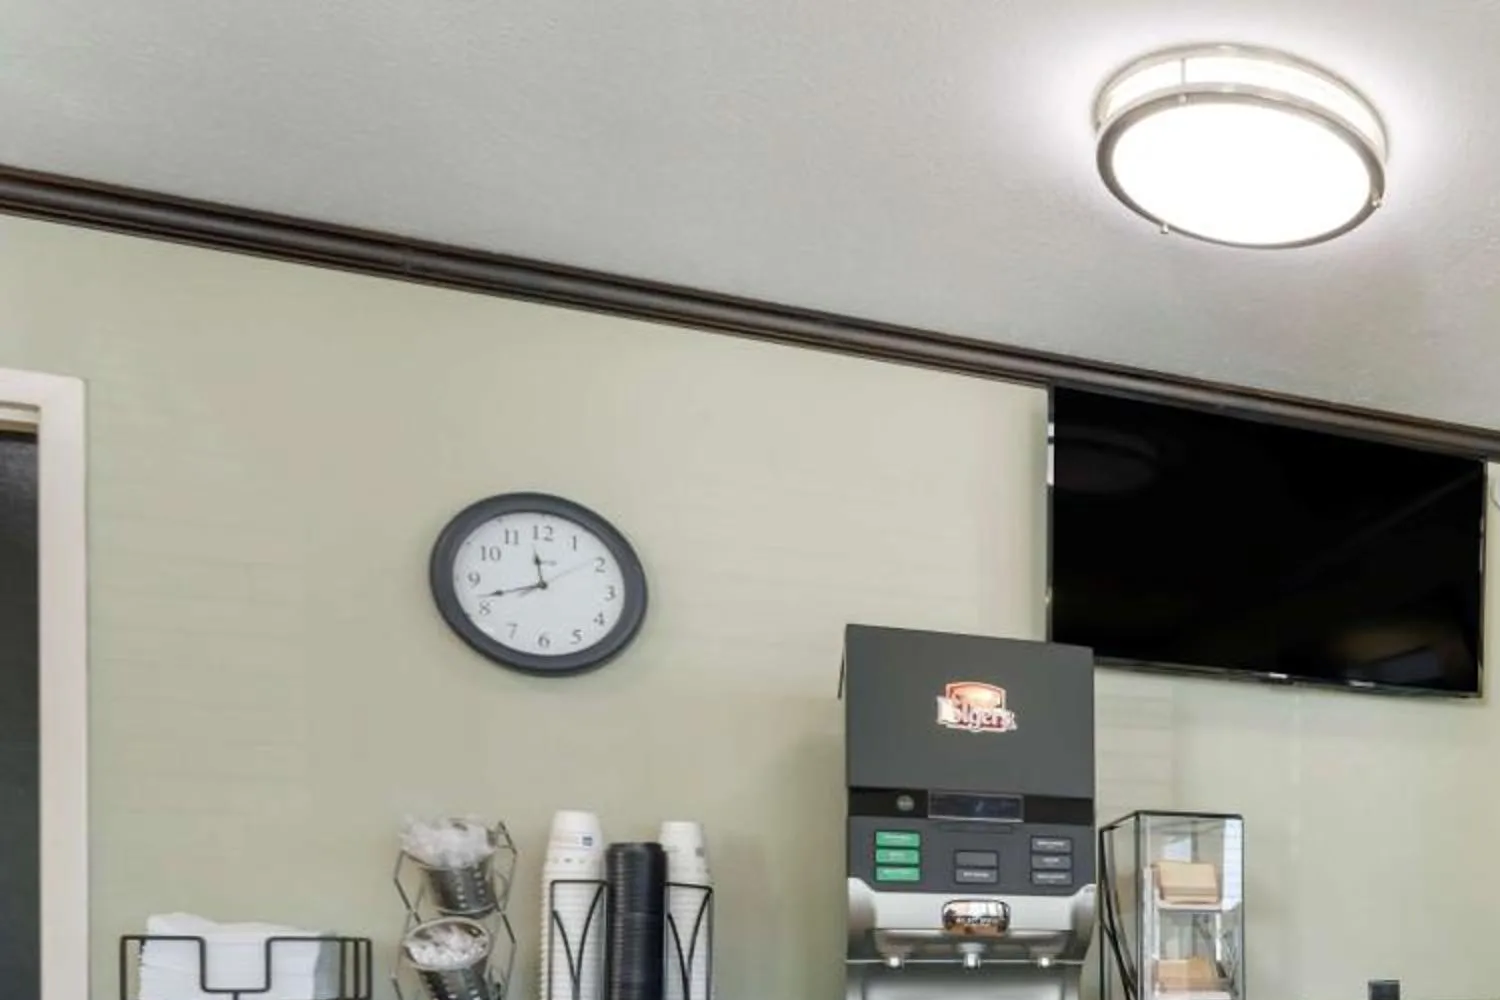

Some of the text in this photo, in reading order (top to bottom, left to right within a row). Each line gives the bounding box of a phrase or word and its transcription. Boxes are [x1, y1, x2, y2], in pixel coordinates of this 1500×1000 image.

[503, 528, 520, 546] 11
[532, 524, 554, 542] 12
[570, 535, 578, 551] 1
[480, 546, 502, 561] 10
[594, 557, 606, 573] 2
[468, 571, 481, 588] 9
[605, 585, 616, 601] 3
[479, 600, 491, 615] 8
[507, 622, 518, 640] 7
[570, 629, 582, 645] 5
[538, 633, 550, 648] 6
